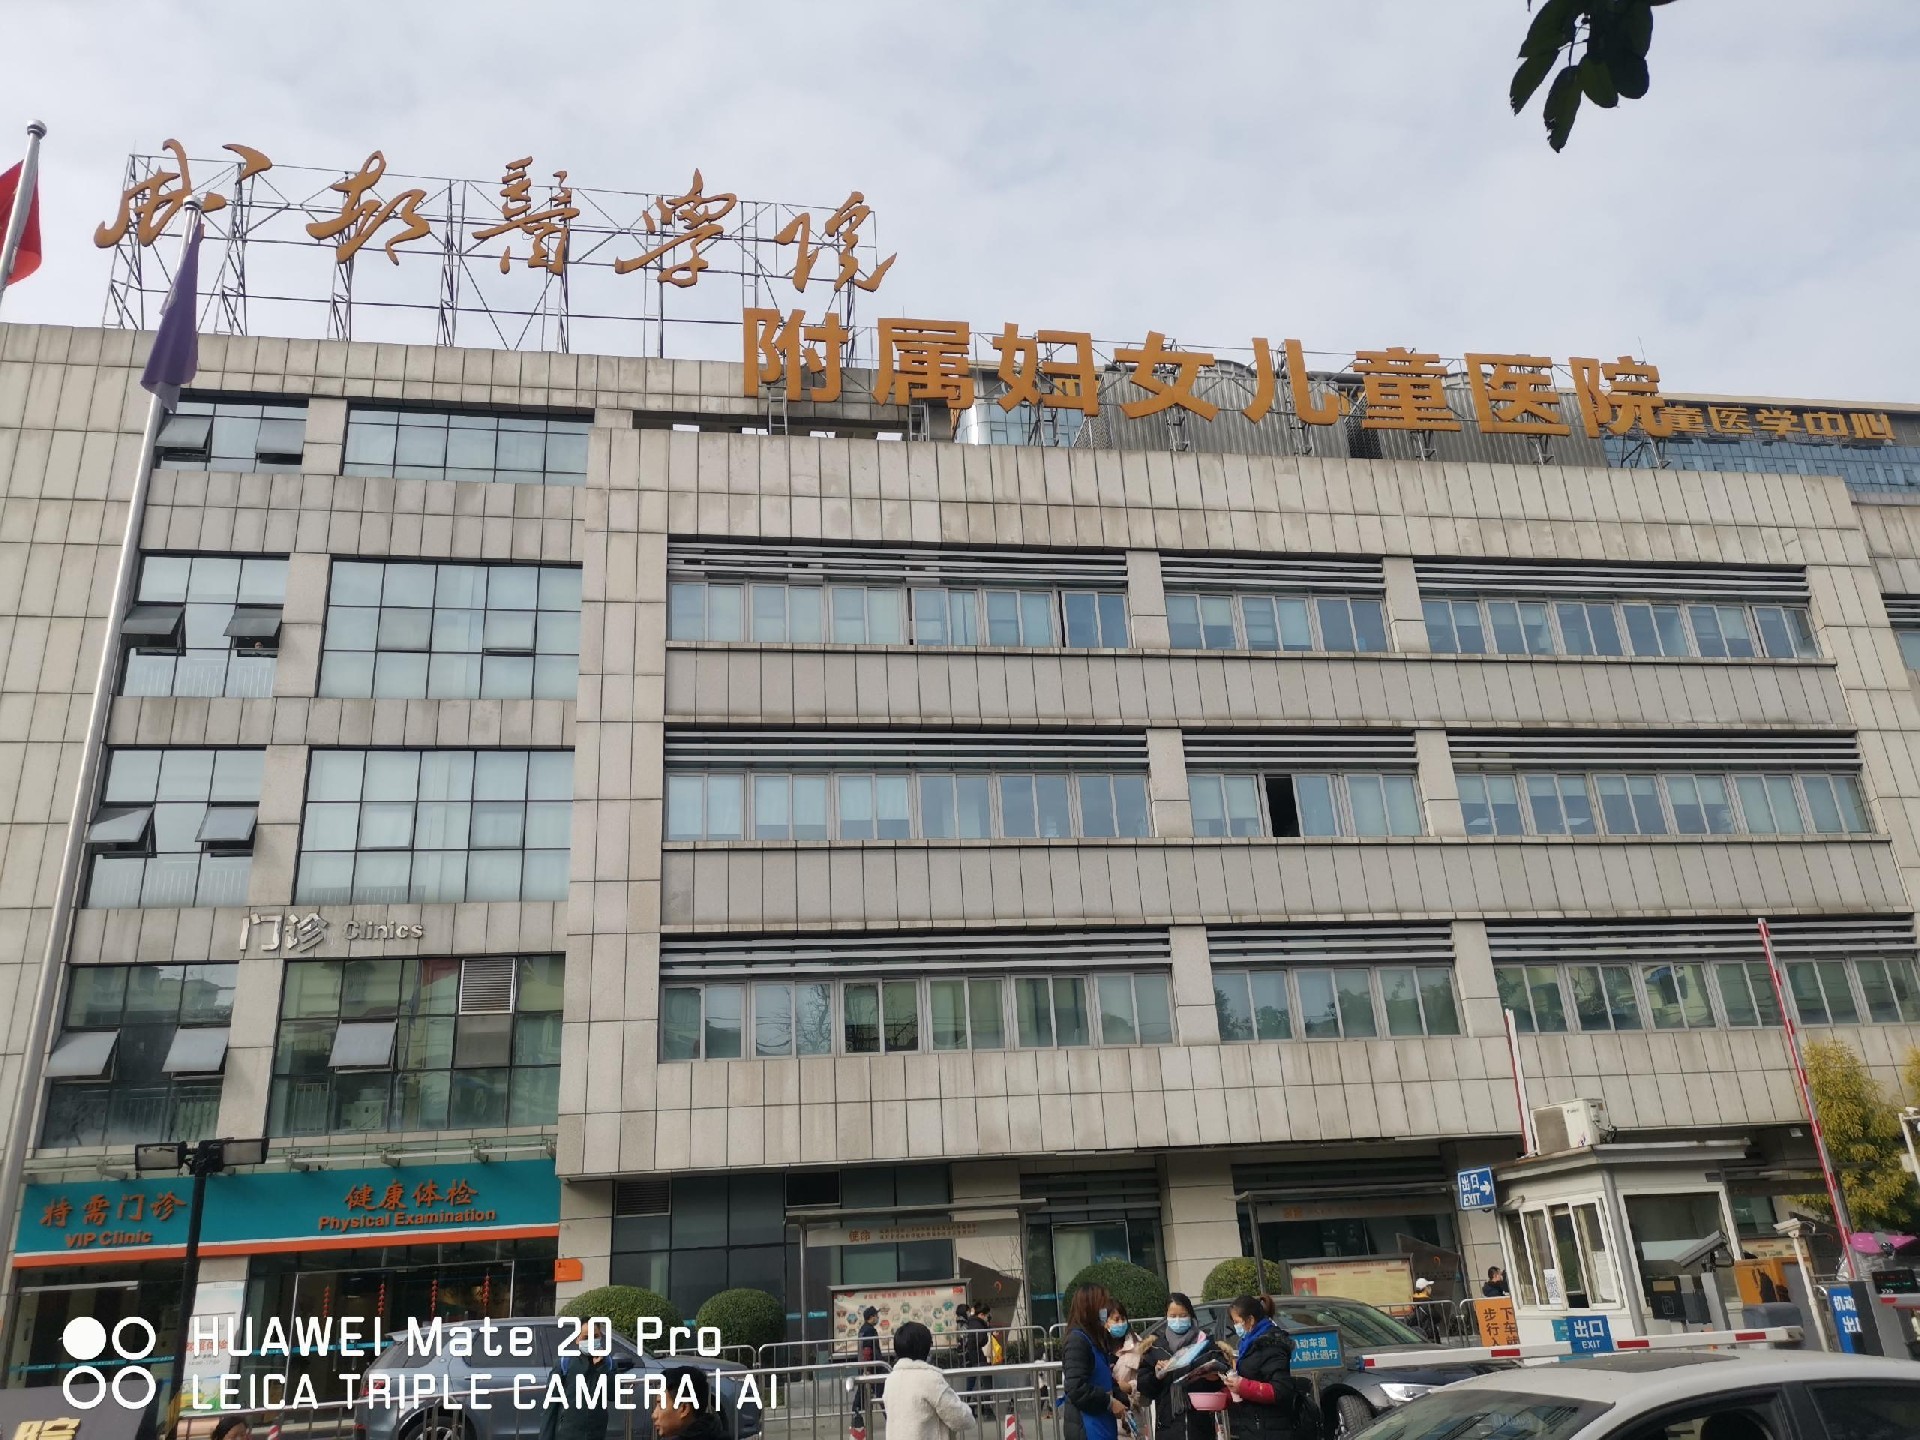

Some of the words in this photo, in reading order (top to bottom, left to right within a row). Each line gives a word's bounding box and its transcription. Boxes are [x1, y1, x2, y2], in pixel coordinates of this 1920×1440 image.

[743, 307, 1673, 439] 附属妇女儿童医院
[239, 912, 329, 952] 门诊
[343, 920, 424, 940] Clinics
[1461, 1173, 1480, 1191] 出口
[344, 1178, 479, 1211] 健康体检
[1463, 1193, 1480, 1207] EXIT
[40, 1190, 187, 1228] 特需门诊
[318, 1211, 390, 1232] Physical
[394, 1209, 496, 1226] Examination
[64, 1232, 97, 1248] VIP
[99, 1230, 153, 1246] Clinic
[1573, 1319, 1604, 1339] 出口
[1581, 1340, 1600, 1349] EXIT
[1290, 1350, 1338, 1362] 人禁止通行
